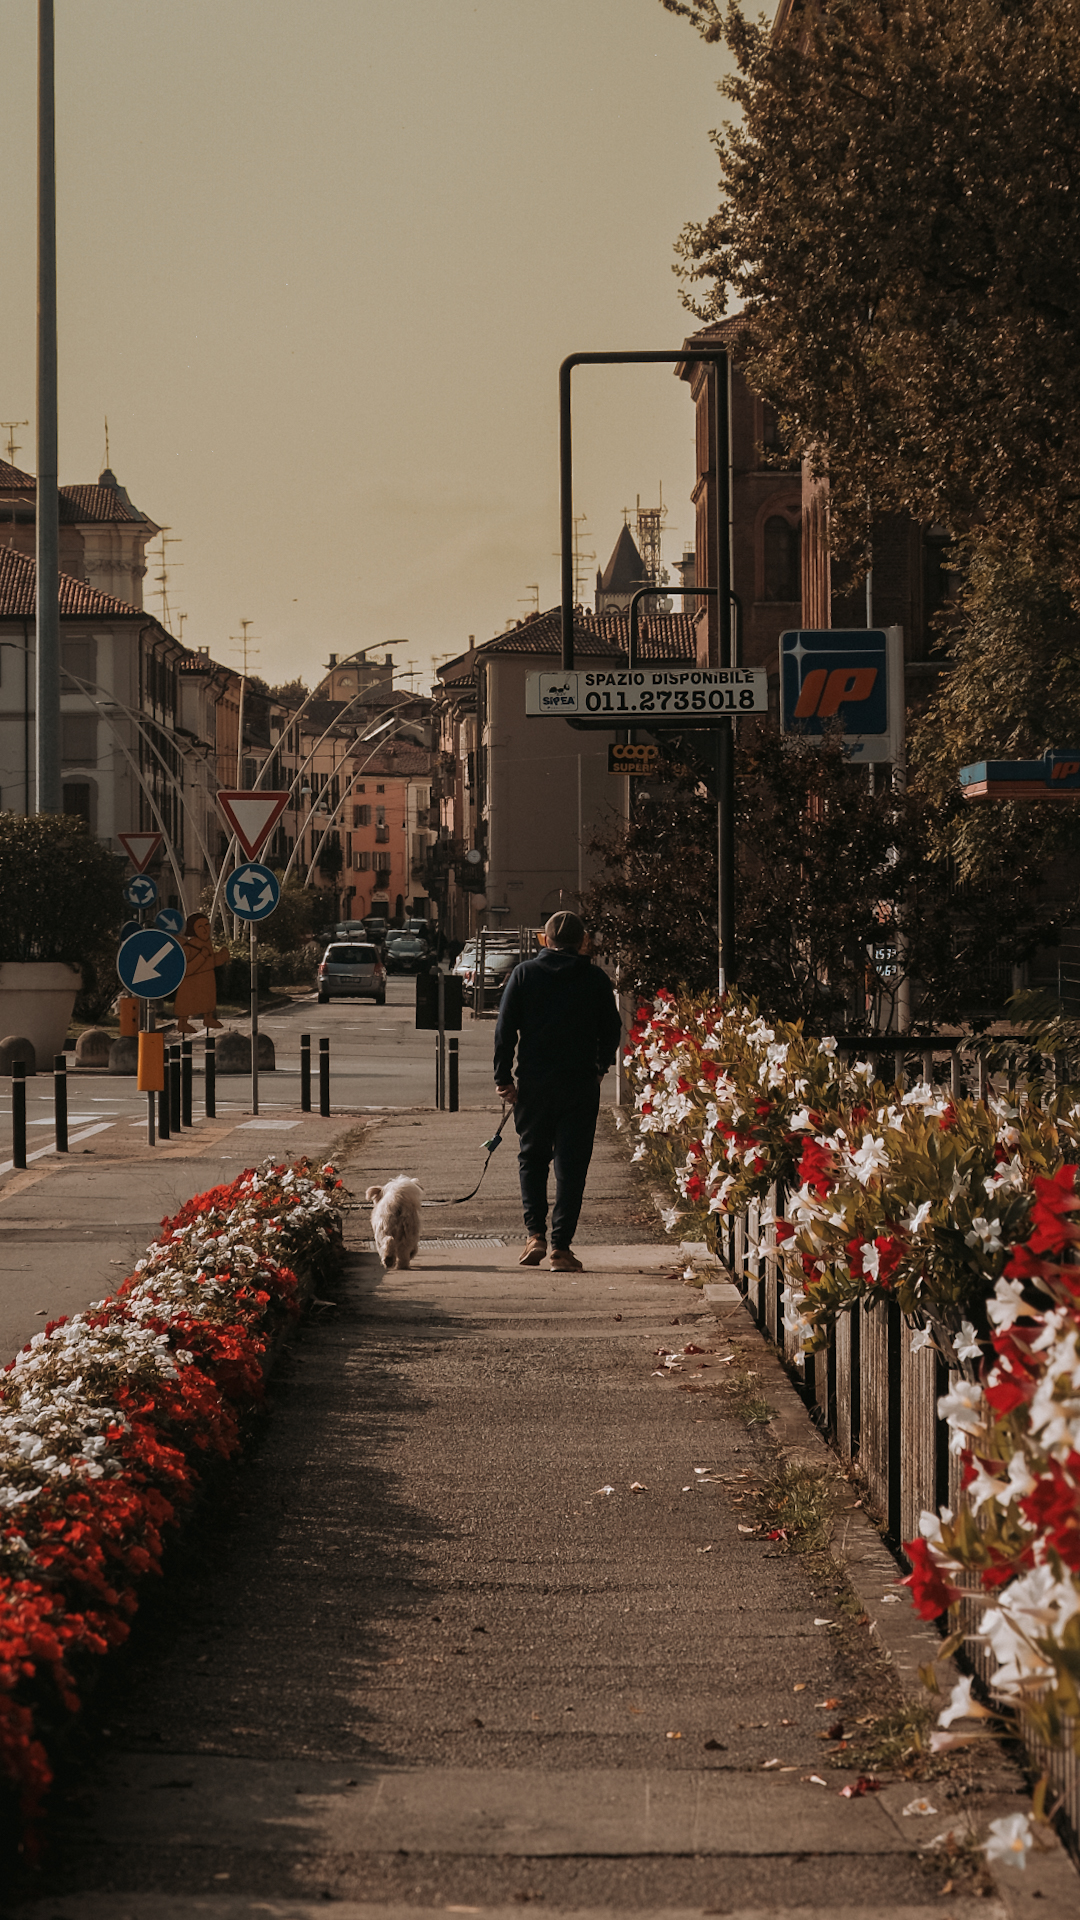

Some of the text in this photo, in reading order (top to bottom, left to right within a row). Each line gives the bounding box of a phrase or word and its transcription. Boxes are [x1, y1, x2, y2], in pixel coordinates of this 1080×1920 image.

[585, 671, 755, 686] SPAZIO DISPONIBILE
[542, 696, 575, 706] SIPEA
[585, 689, 755, 712] 011.2735018
